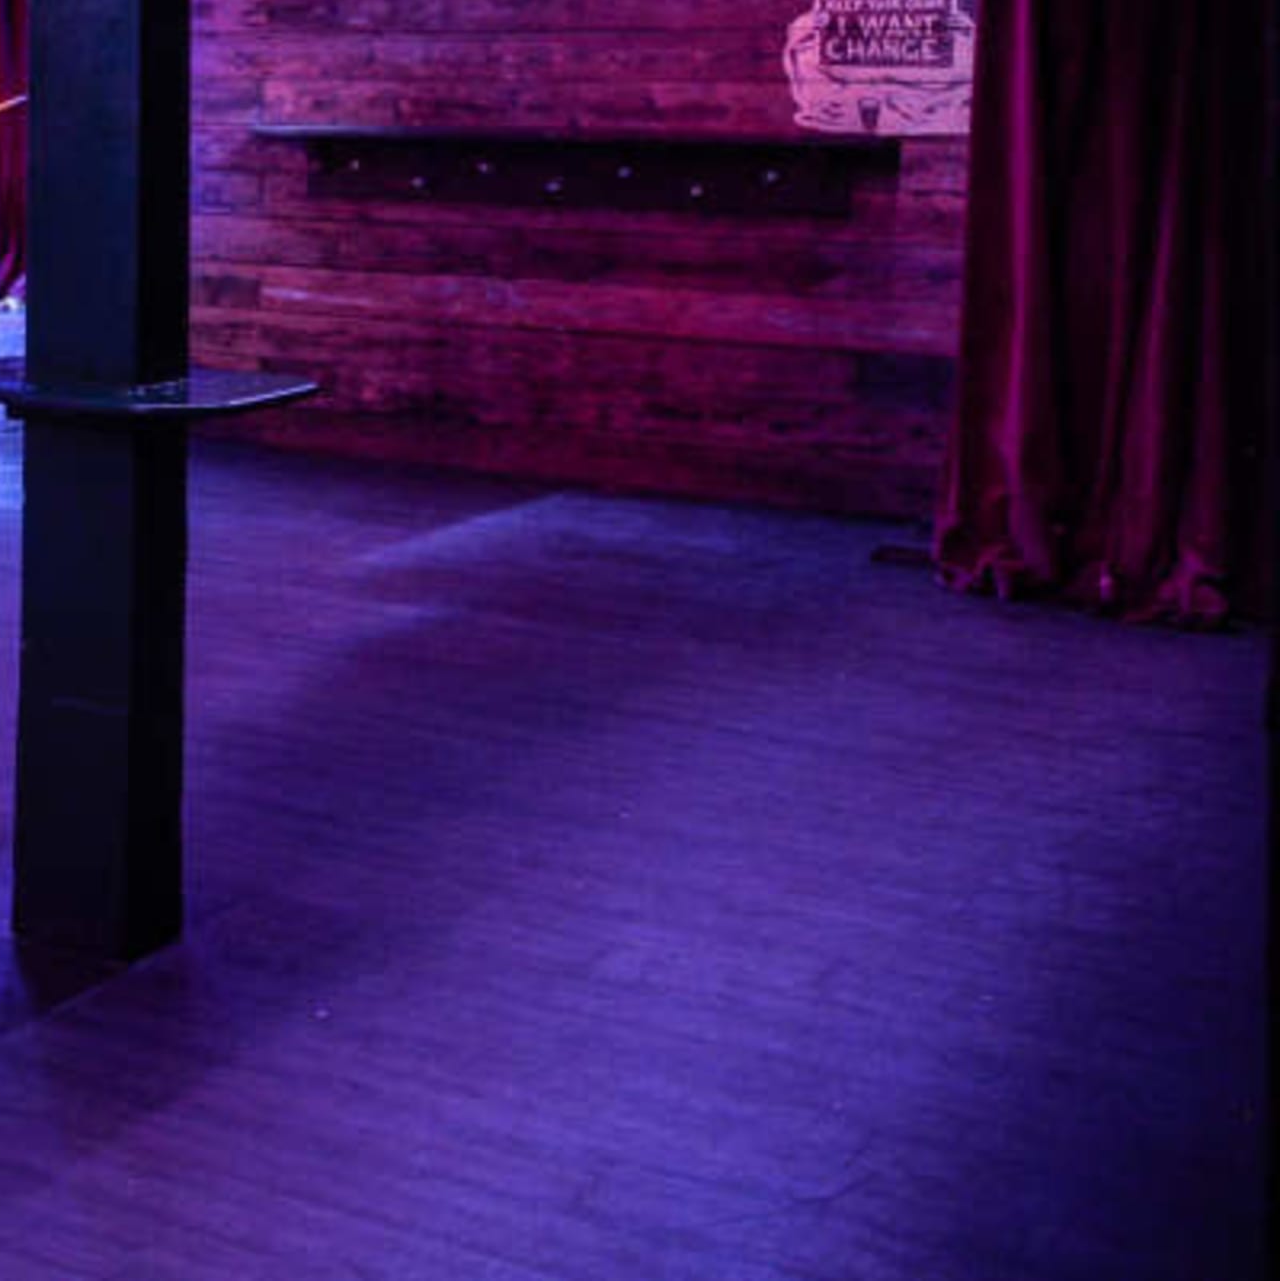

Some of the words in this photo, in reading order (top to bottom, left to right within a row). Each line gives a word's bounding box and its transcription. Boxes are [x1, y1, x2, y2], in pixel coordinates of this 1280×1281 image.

[836, 15, 846, 36] I
[858, 12, 939, 37] WANT
[825, 37, 941, 61] CHANGE
